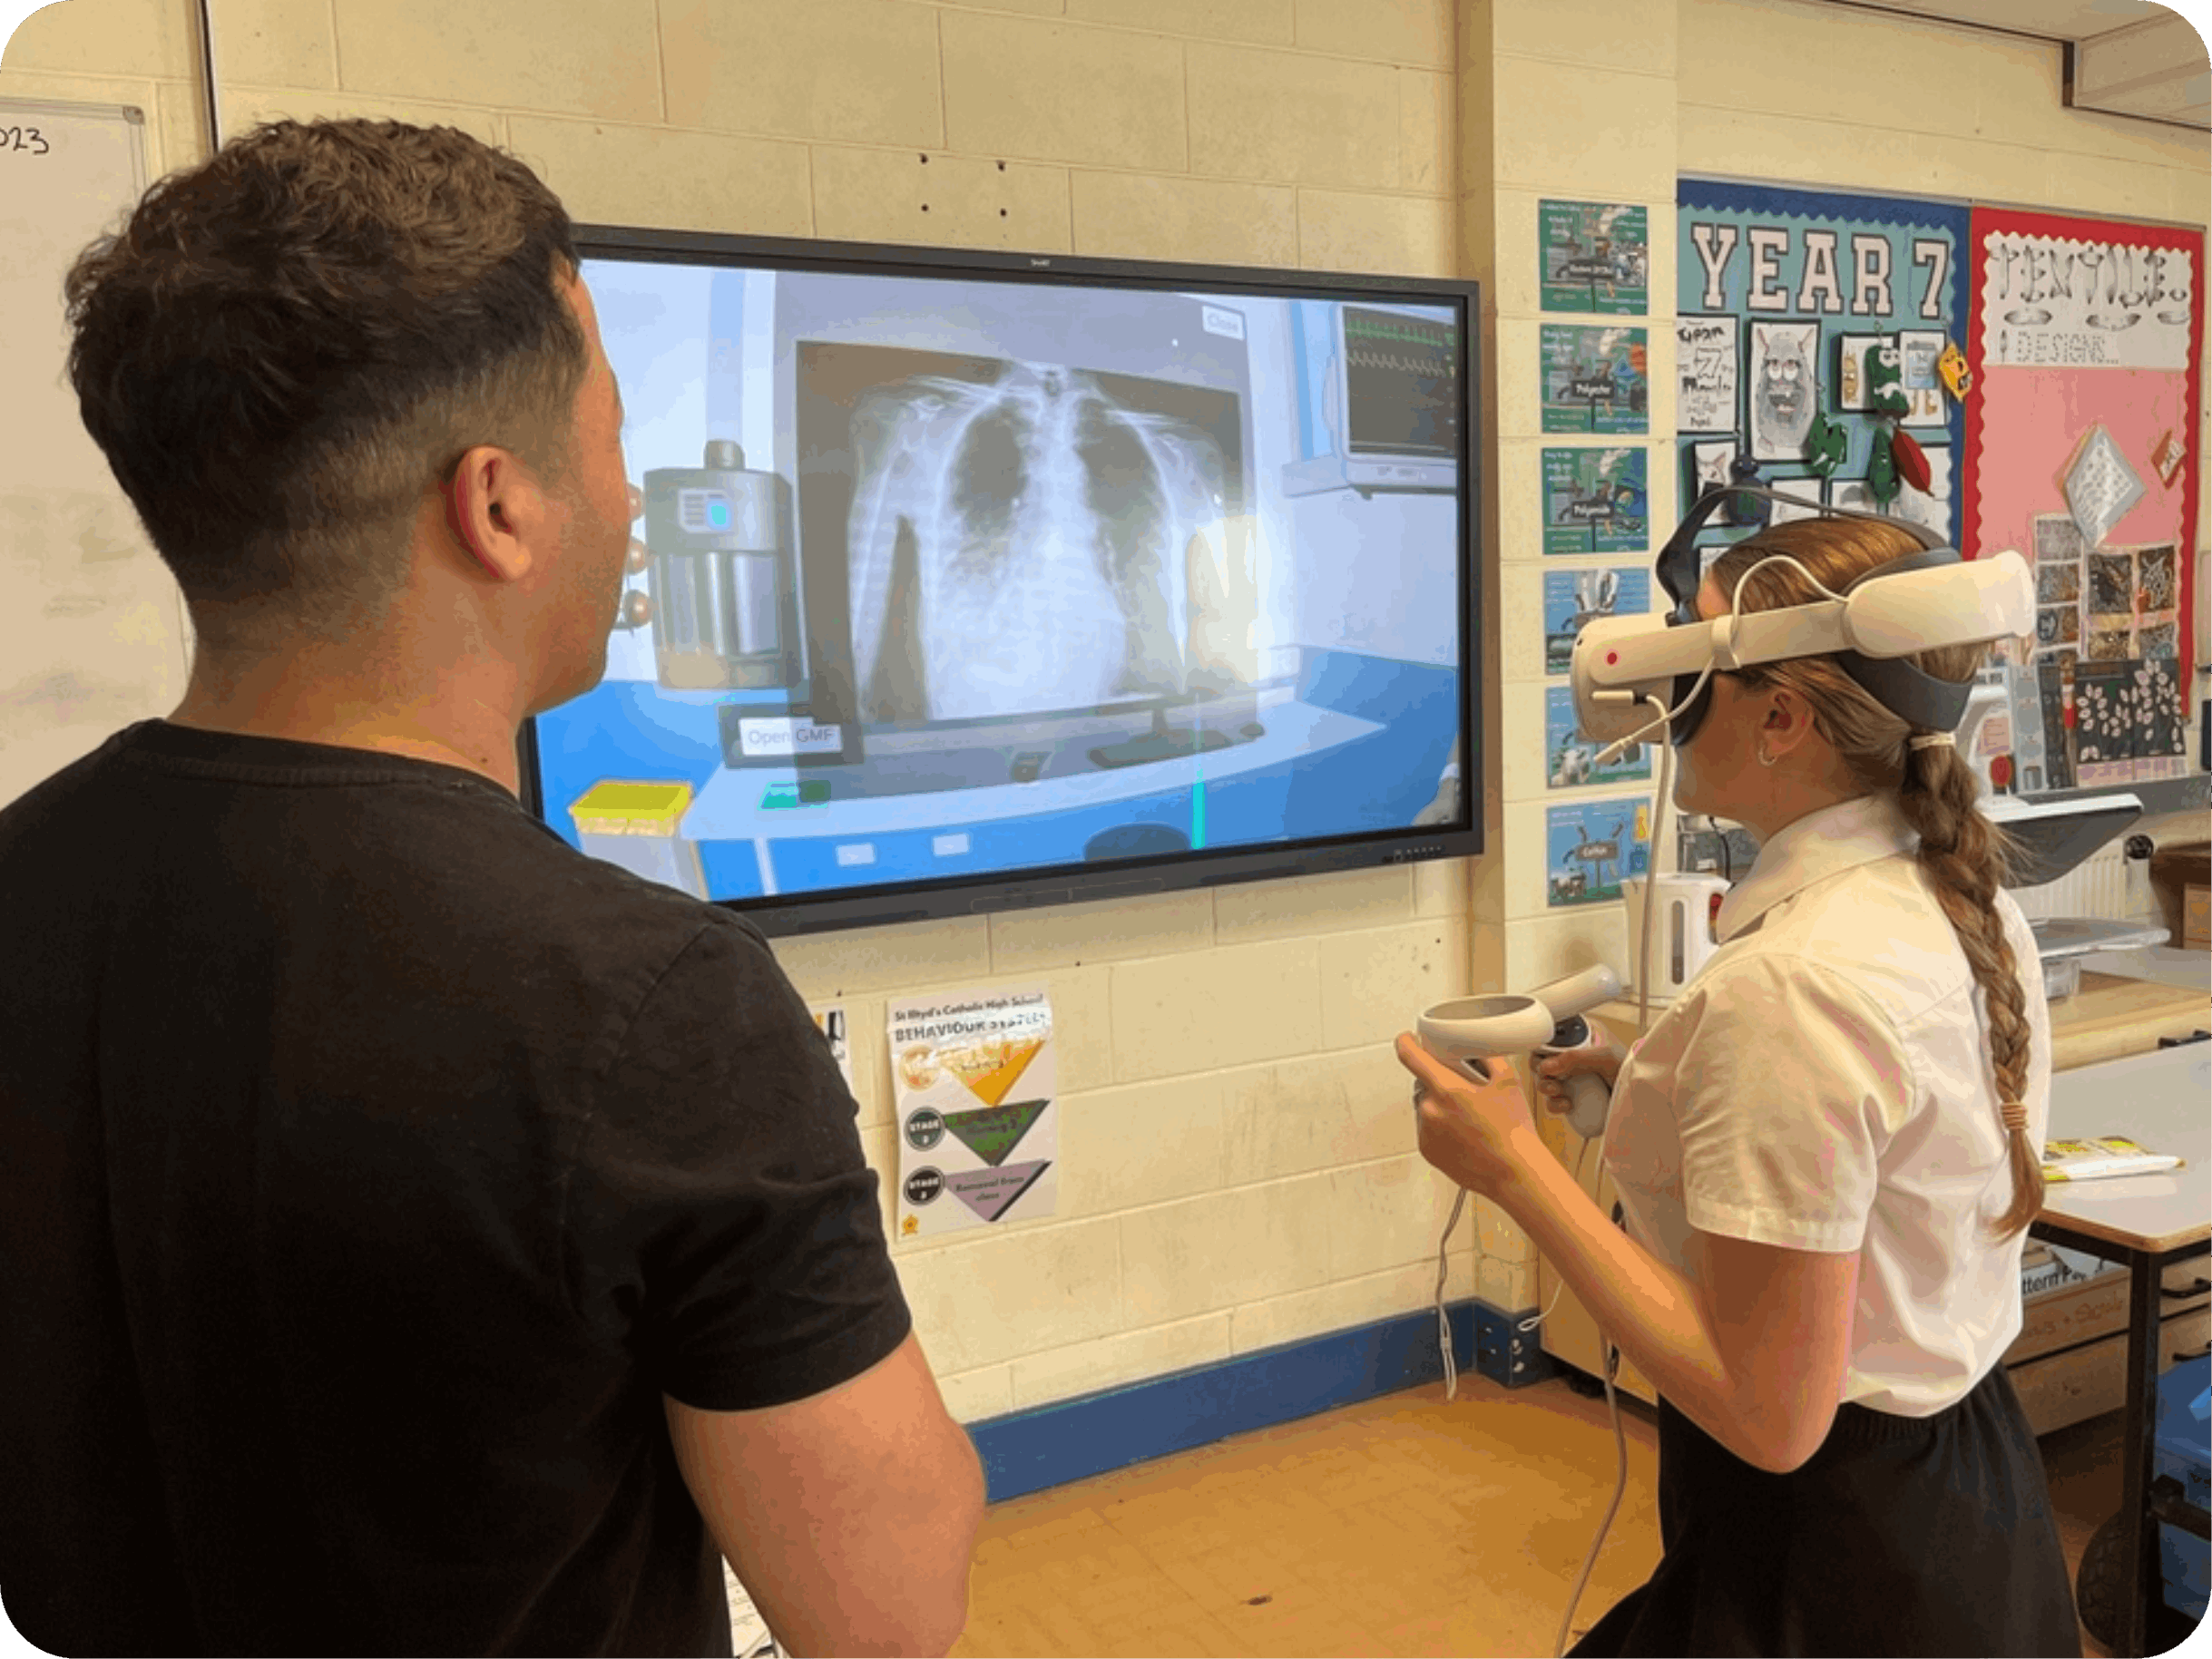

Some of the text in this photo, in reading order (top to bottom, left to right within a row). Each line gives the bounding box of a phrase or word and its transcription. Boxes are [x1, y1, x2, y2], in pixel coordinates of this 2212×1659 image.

[1690, 222, 1952, 320] YEAR 7
[748, 728, 833, 747] Open GMF
[942, 1004, 983, 1015] Catholic
[985, 999, 1008, 1010] High
[1012, 993, 1043, 1006] School
[895, 1020, 986, 1042] BEHAVIOUR
